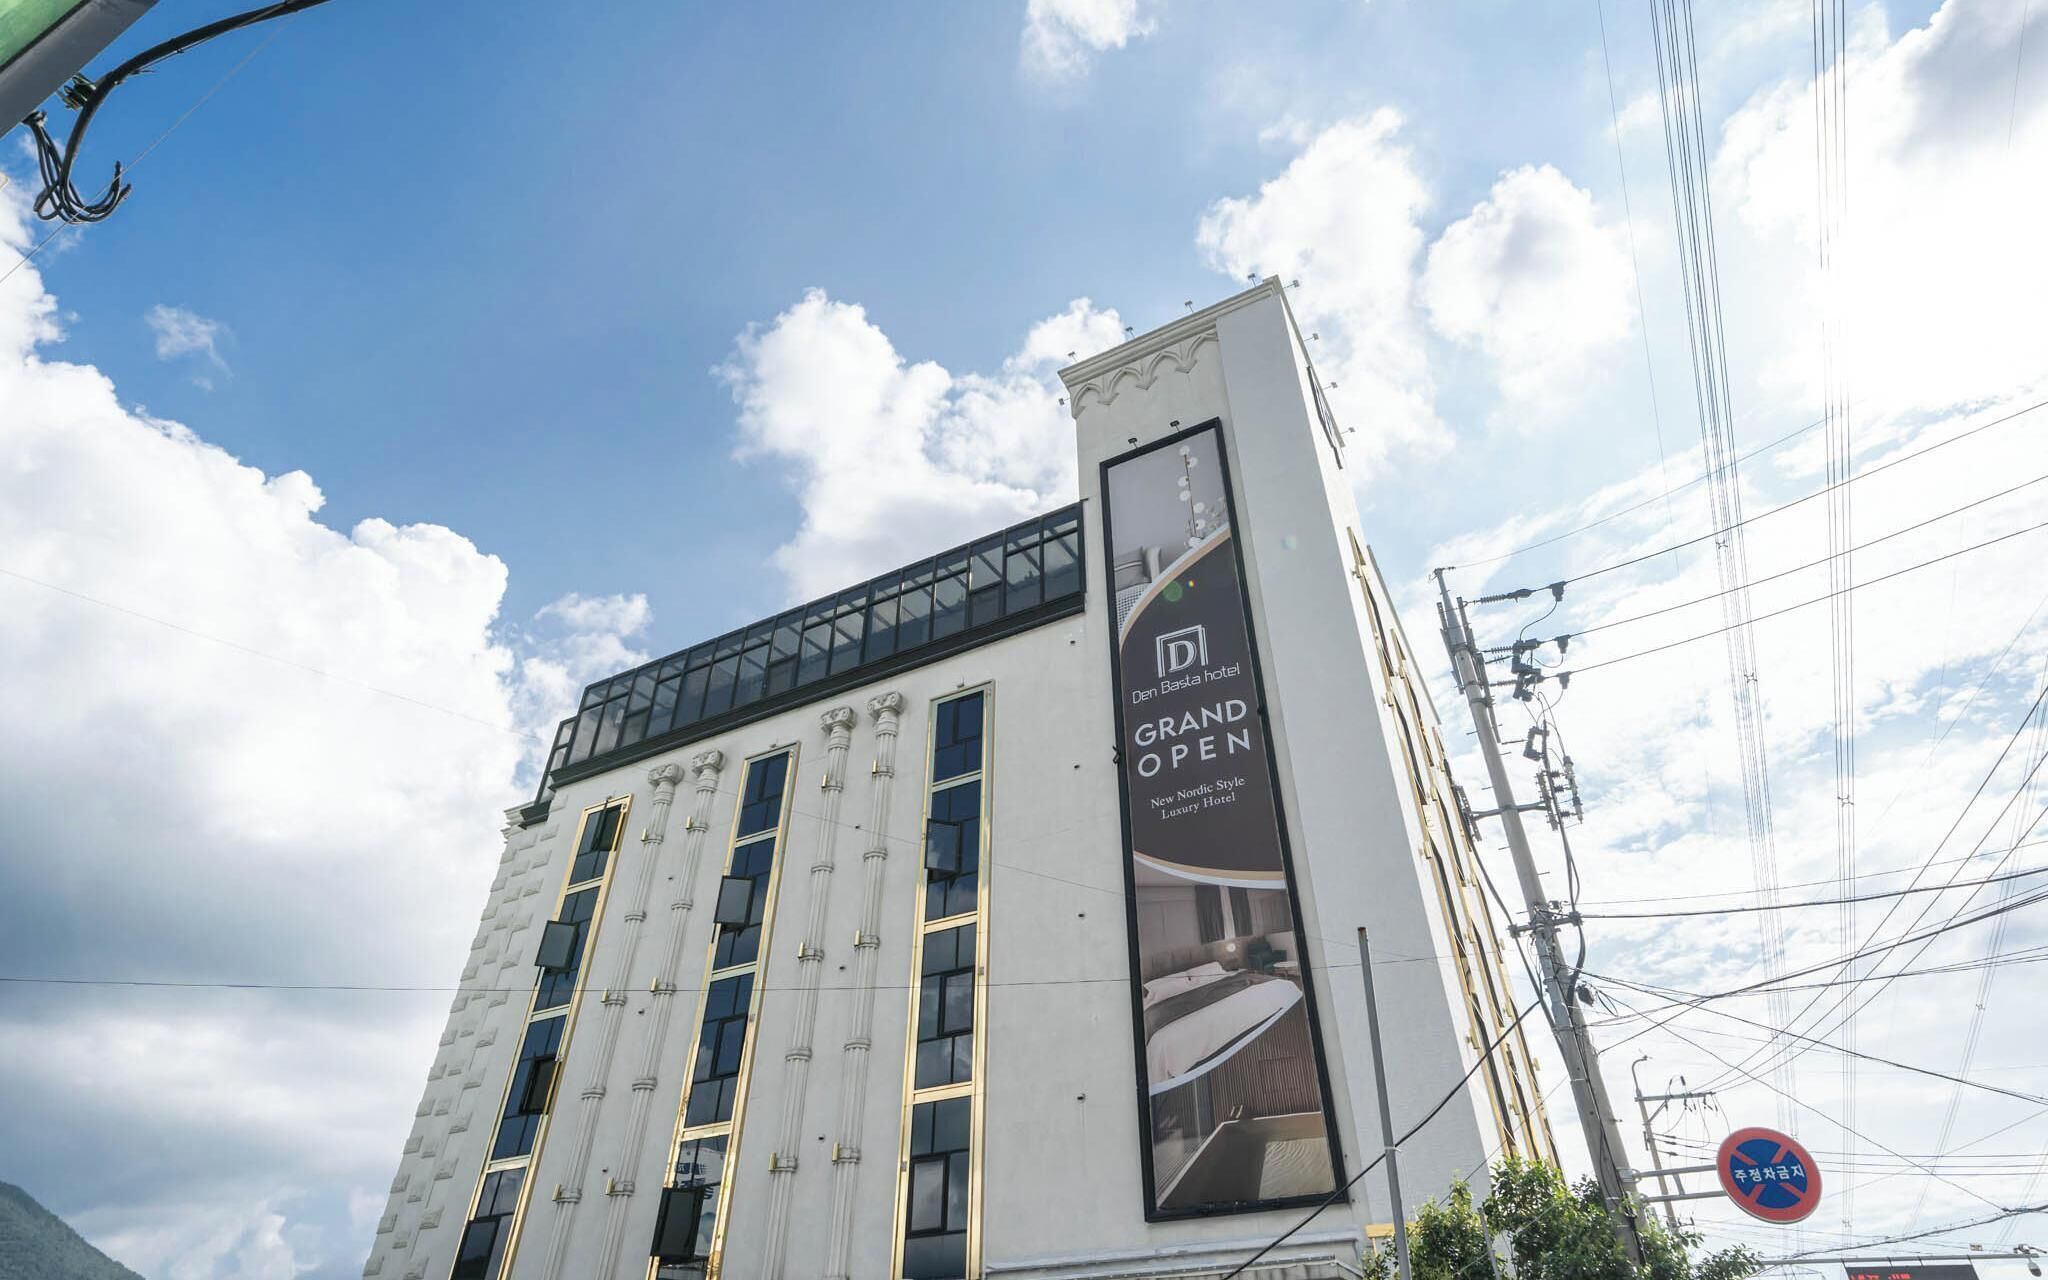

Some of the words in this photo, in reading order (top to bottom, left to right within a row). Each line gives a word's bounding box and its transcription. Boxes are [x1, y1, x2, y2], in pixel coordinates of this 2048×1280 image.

[1132, 687, 1158, 704] Den
[1160, 674, 1201, 694] Basta
[1204, 662, 1241, 682] hotel
[1134, 699, 1247, 747] GRAND
[1137, 728, 1251, 778] OPEN
[1151, 797, 1174, 809] New
[1177, 783, 1214, 801] Nordic
[1216, 777, 1246, 791] Style
[1161, 802, 1200, 820] Luxury
[1203, 791, 1236, 808] Hotel
[1734, 1163, 1805, 1184] 주정차금지
